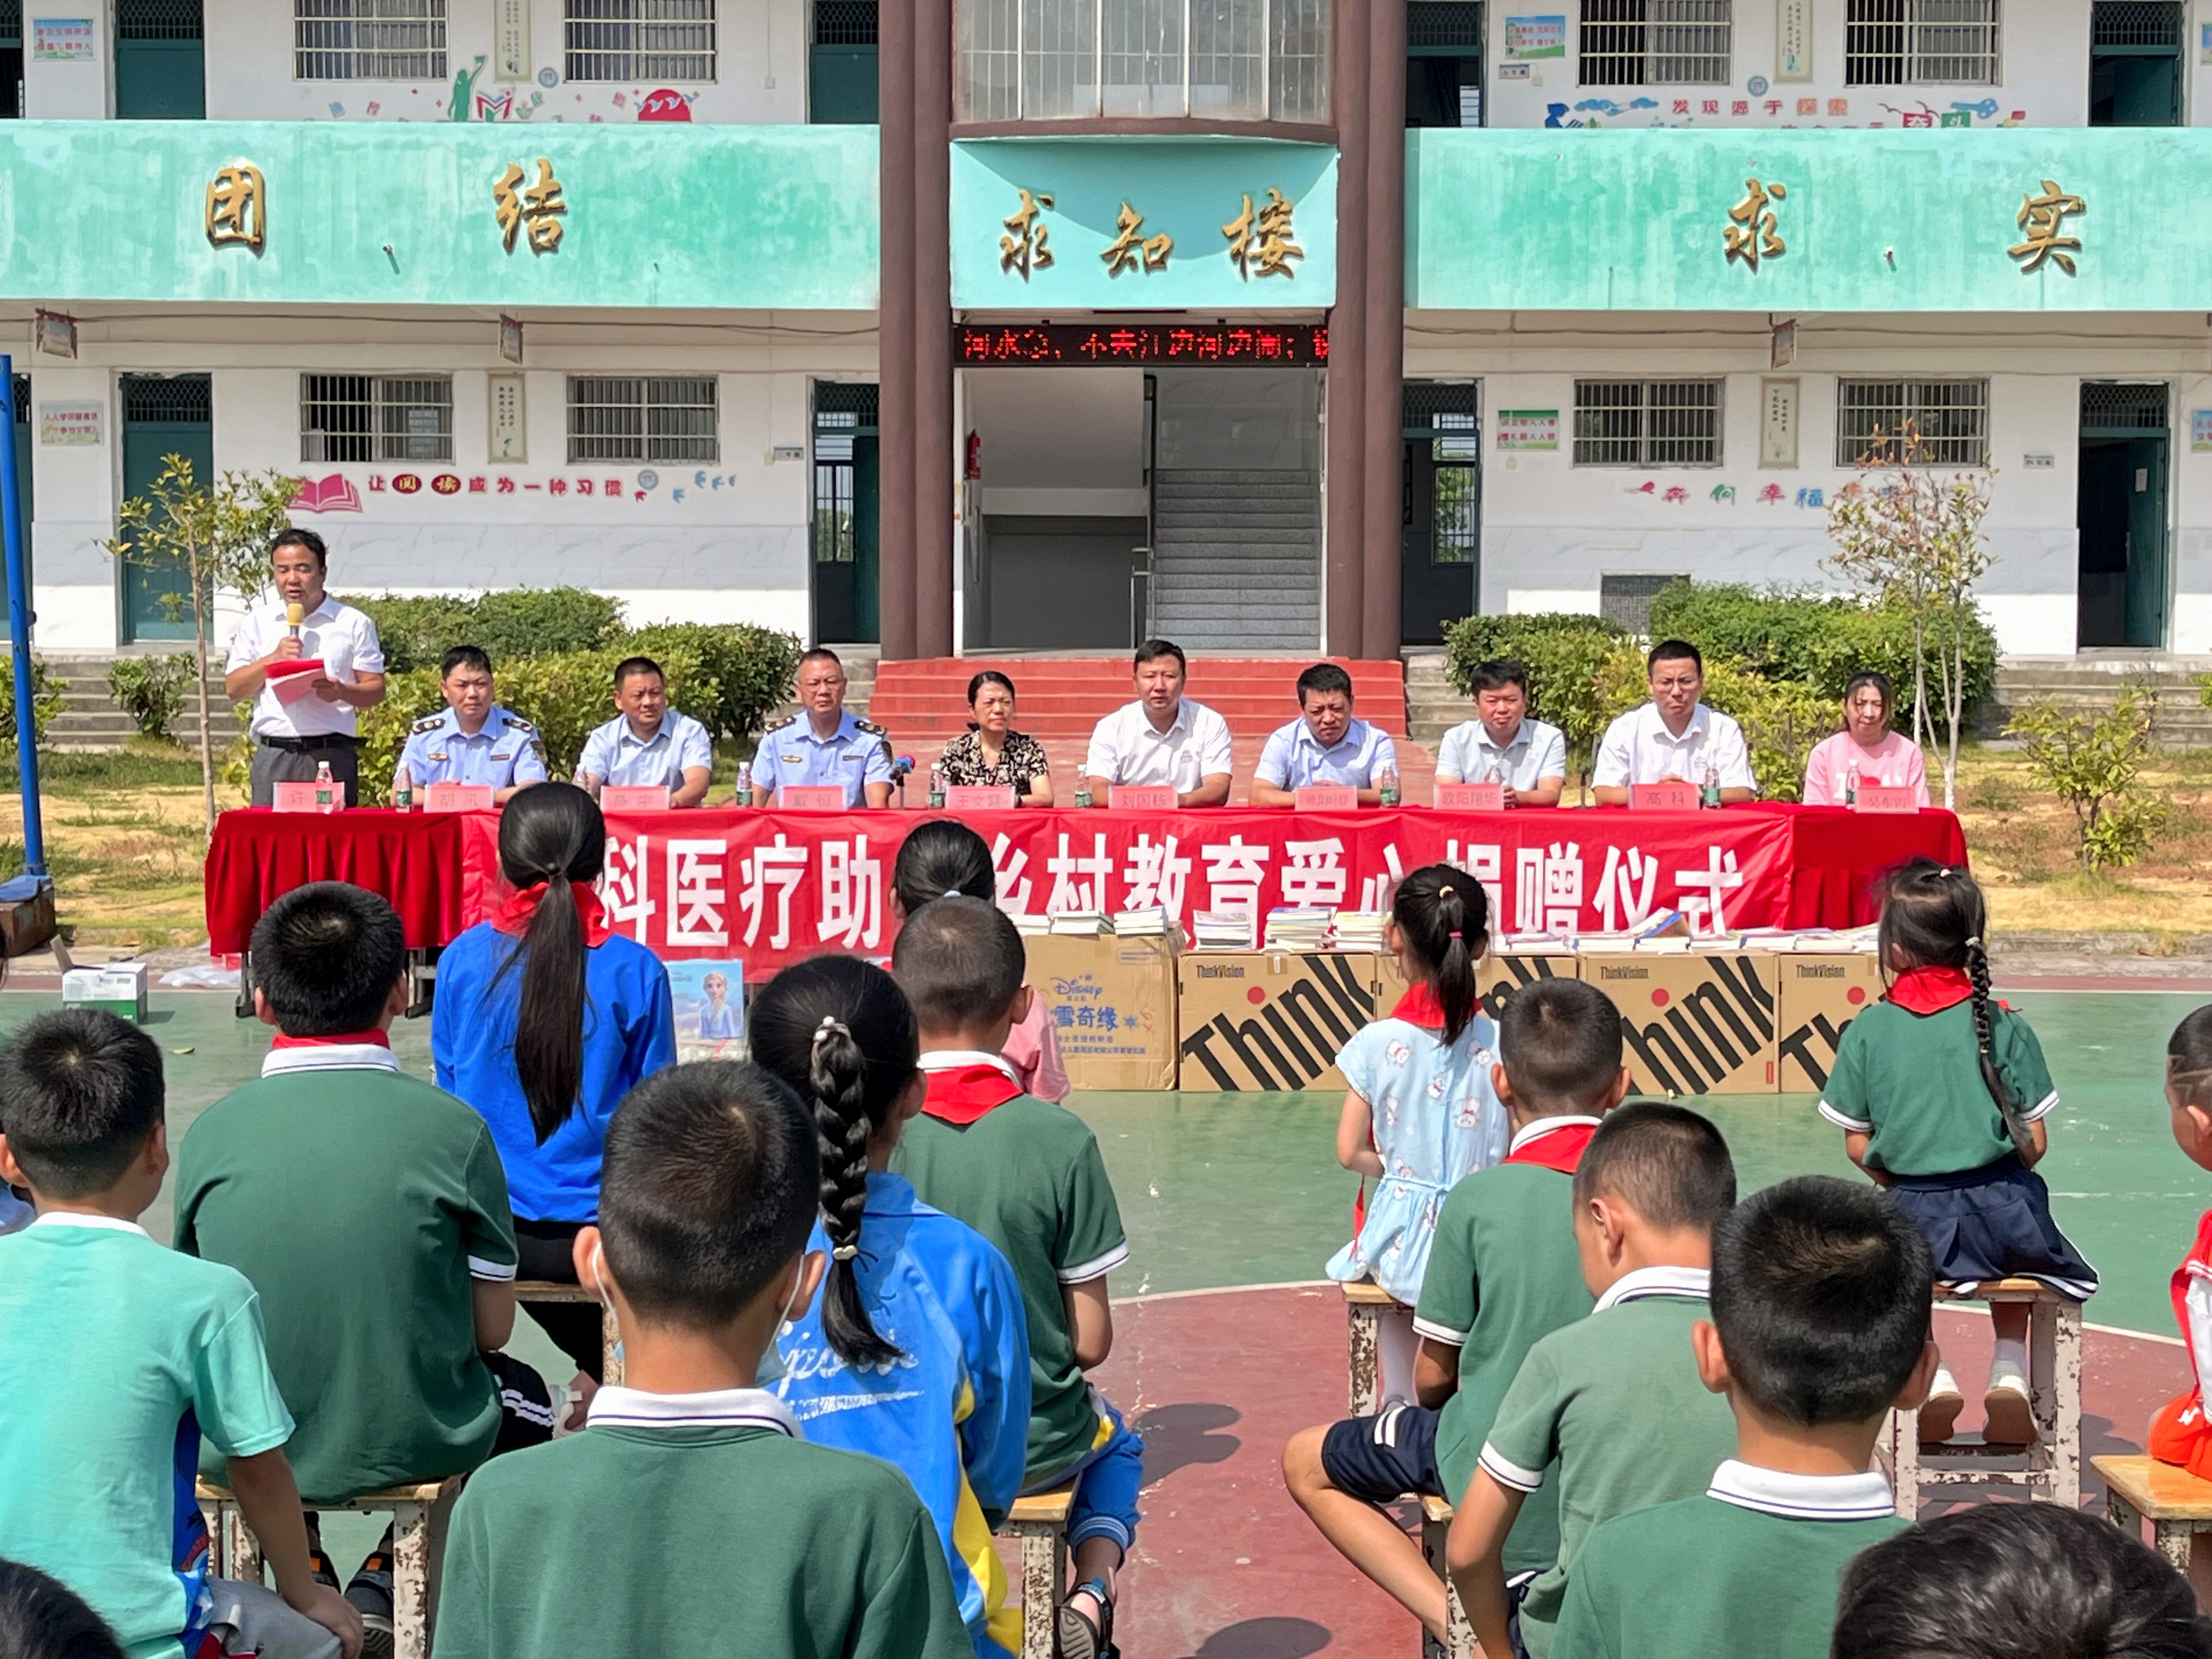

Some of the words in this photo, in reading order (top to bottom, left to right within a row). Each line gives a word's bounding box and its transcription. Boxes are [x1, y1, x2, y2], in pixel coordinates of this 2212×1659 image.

[1672, 98, 1848, 117] 发现源于探索
[206, 164, 267, 258] 团
[493, 158, 568, 257] 结
[1724, 178, 1787, 275] 求
[2007, 179, 2087, 278] 实
[368, 474, 622, 498] 让阅读成为一种习惯
[1196, 964, 1246, 978] ThinkVision
[1600, 966, 1649, 979] ThinkVision
[1796, 964, 1846, 979] ThinkVision
[1051, 1005, 1119, 1031] 雪奇缘
[1182, 955, 1374, 1091] Think
[1621, 956, 1774, 1095] hink
